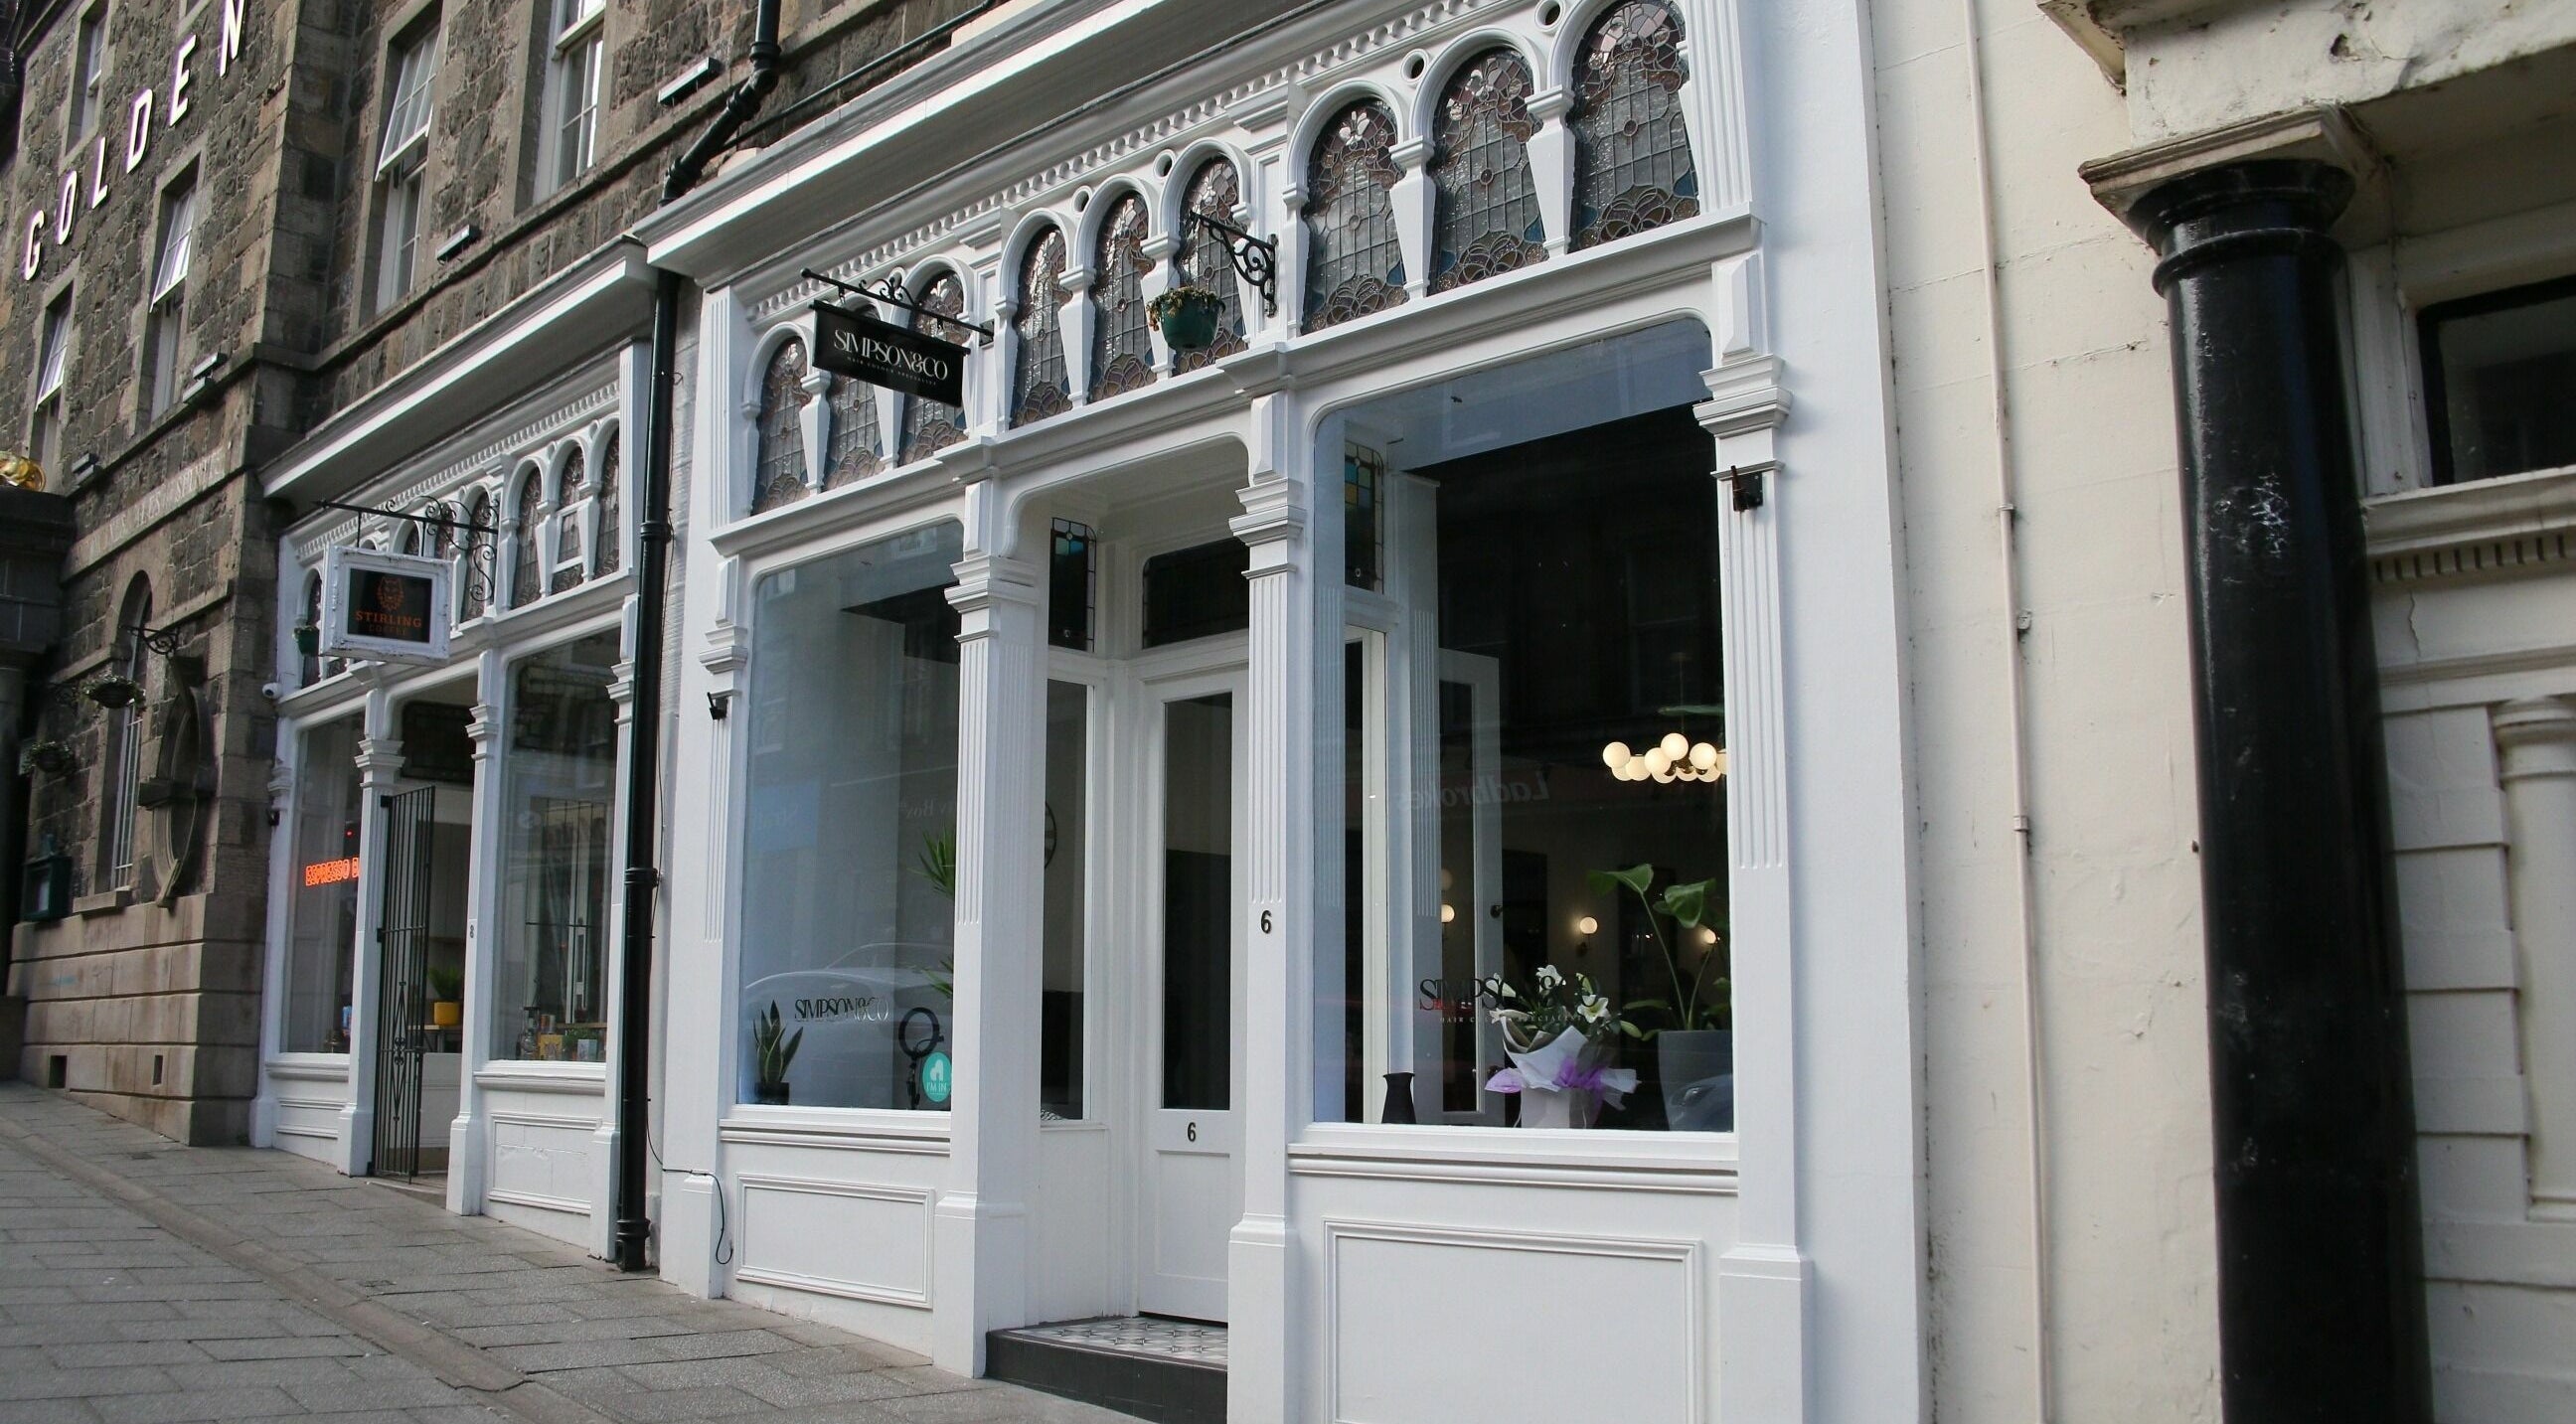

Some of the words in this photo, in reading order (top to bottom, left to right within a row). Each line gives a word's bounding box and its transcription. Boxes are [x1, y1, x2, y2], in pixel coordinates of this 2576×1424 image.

[24, 0, 245, 281] GOLDEN
[833, 329, 948, 381] SIMPSON&CO
[355, 610, 422, 628] STIRLING
[305, 859, 351, 886] ESPRESSO
[1259, 909, 1272, 934] 6
[1187, 1121, 1197, 1142] 6
